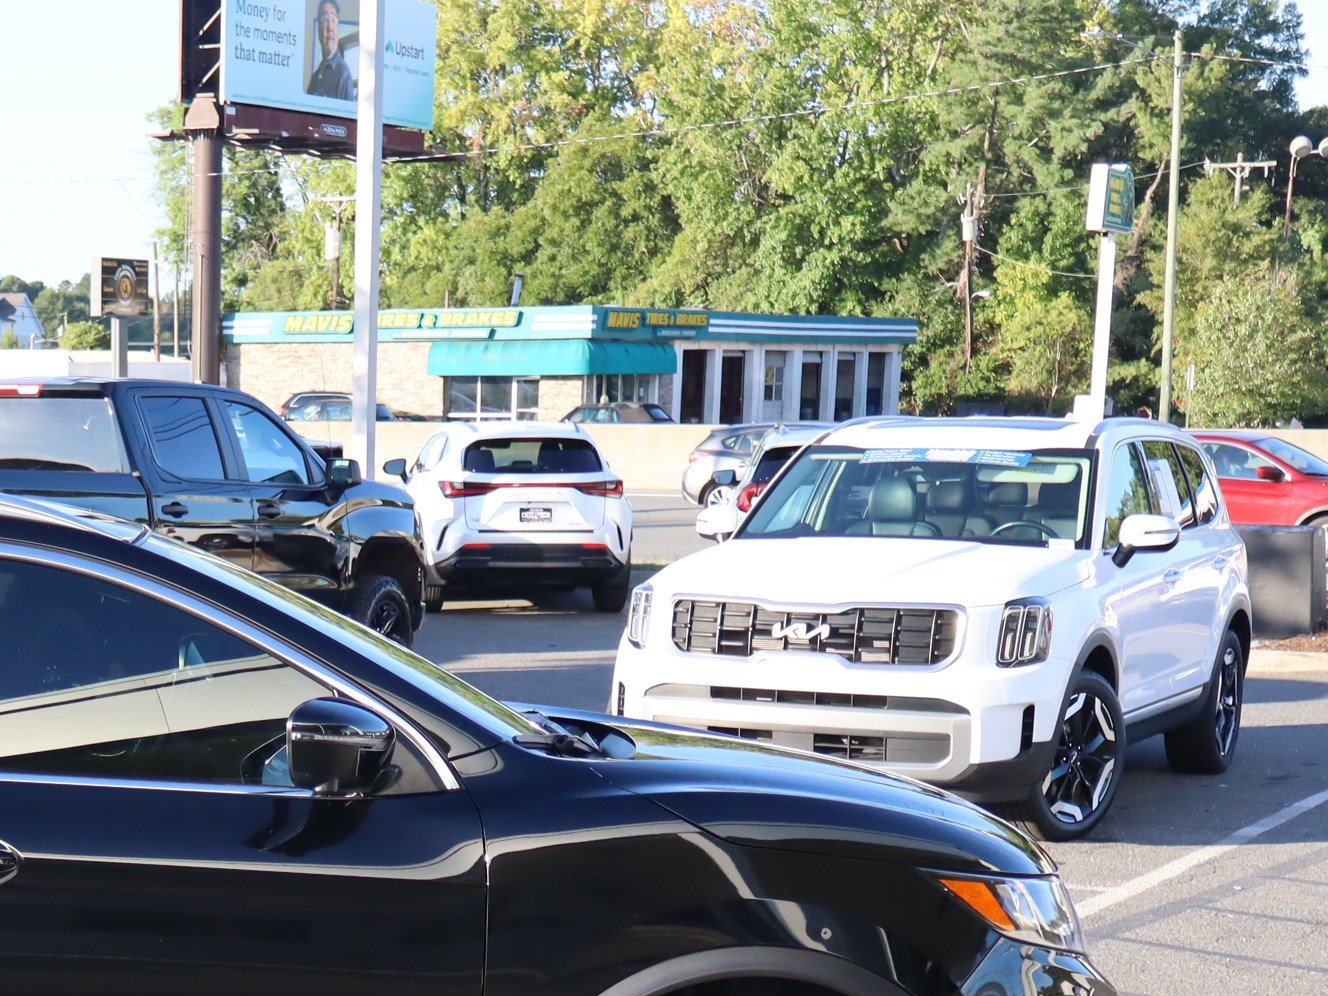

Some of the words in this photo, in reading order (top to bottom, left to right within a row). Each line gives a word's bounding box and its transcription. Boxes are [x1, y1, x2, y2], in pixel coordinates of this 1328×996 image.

[235, 0, 270, 22] Money
[273, 5, 286, 21] for
[235, 21, 251, 38] the
[253, 28, 297, 46] moments
[235, 42, 256, 62] that
[395, 41, 424, 60] Upstart
[285, 315, 352, 332] MAVIS
[377, 313, 419, 327] IRES
[438, 311, 517, 327] BRAKES
[607, 312, 640, 328] MAVIS
